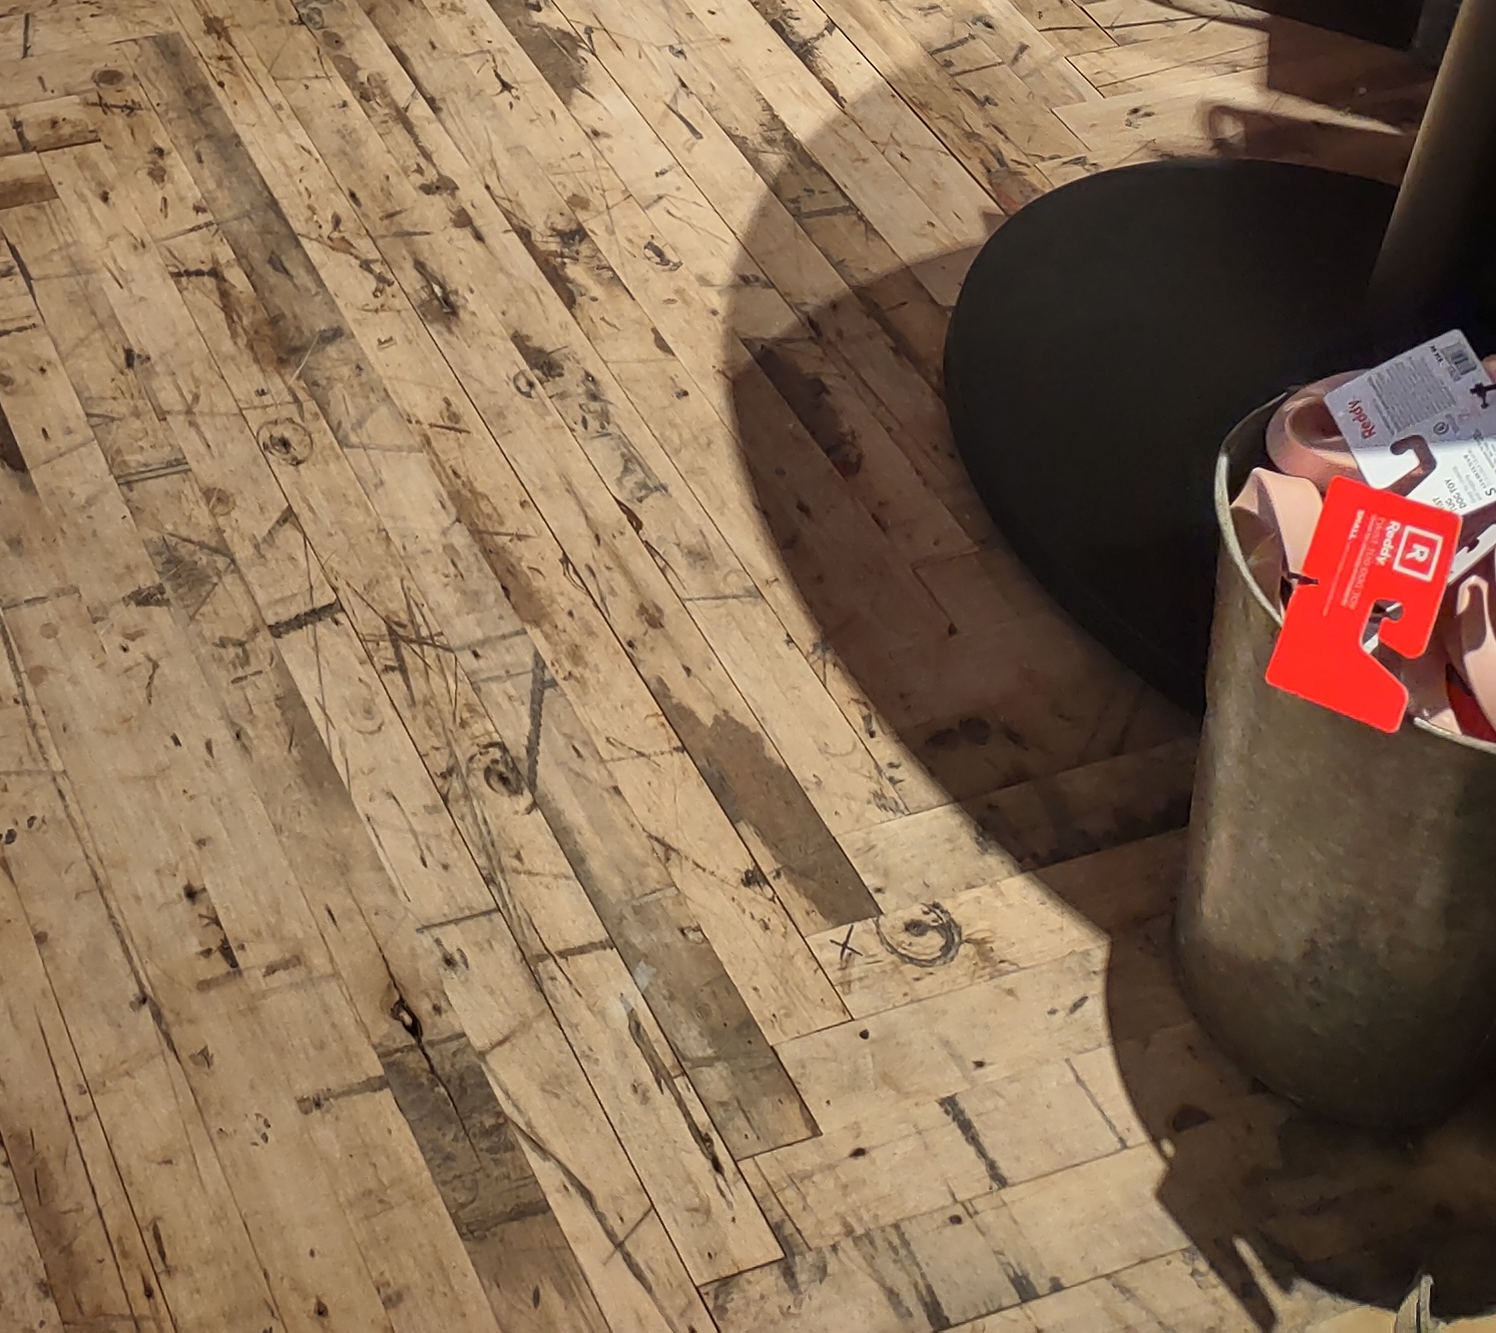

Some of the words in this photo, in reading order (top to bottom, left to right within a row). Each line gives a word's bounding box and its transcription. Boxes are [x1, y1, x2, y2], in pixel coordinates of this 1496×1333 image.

[1348, 400, 1376, 439] Reddy
[1444, 478, 1457, 493] TOY
[1452, 491, 1466, 509] DOG
[1348, 509, 1365, 540] SMALL
[1376, 520, 1401, 566] Reddy
[1405, 543, 1430, 563] R
